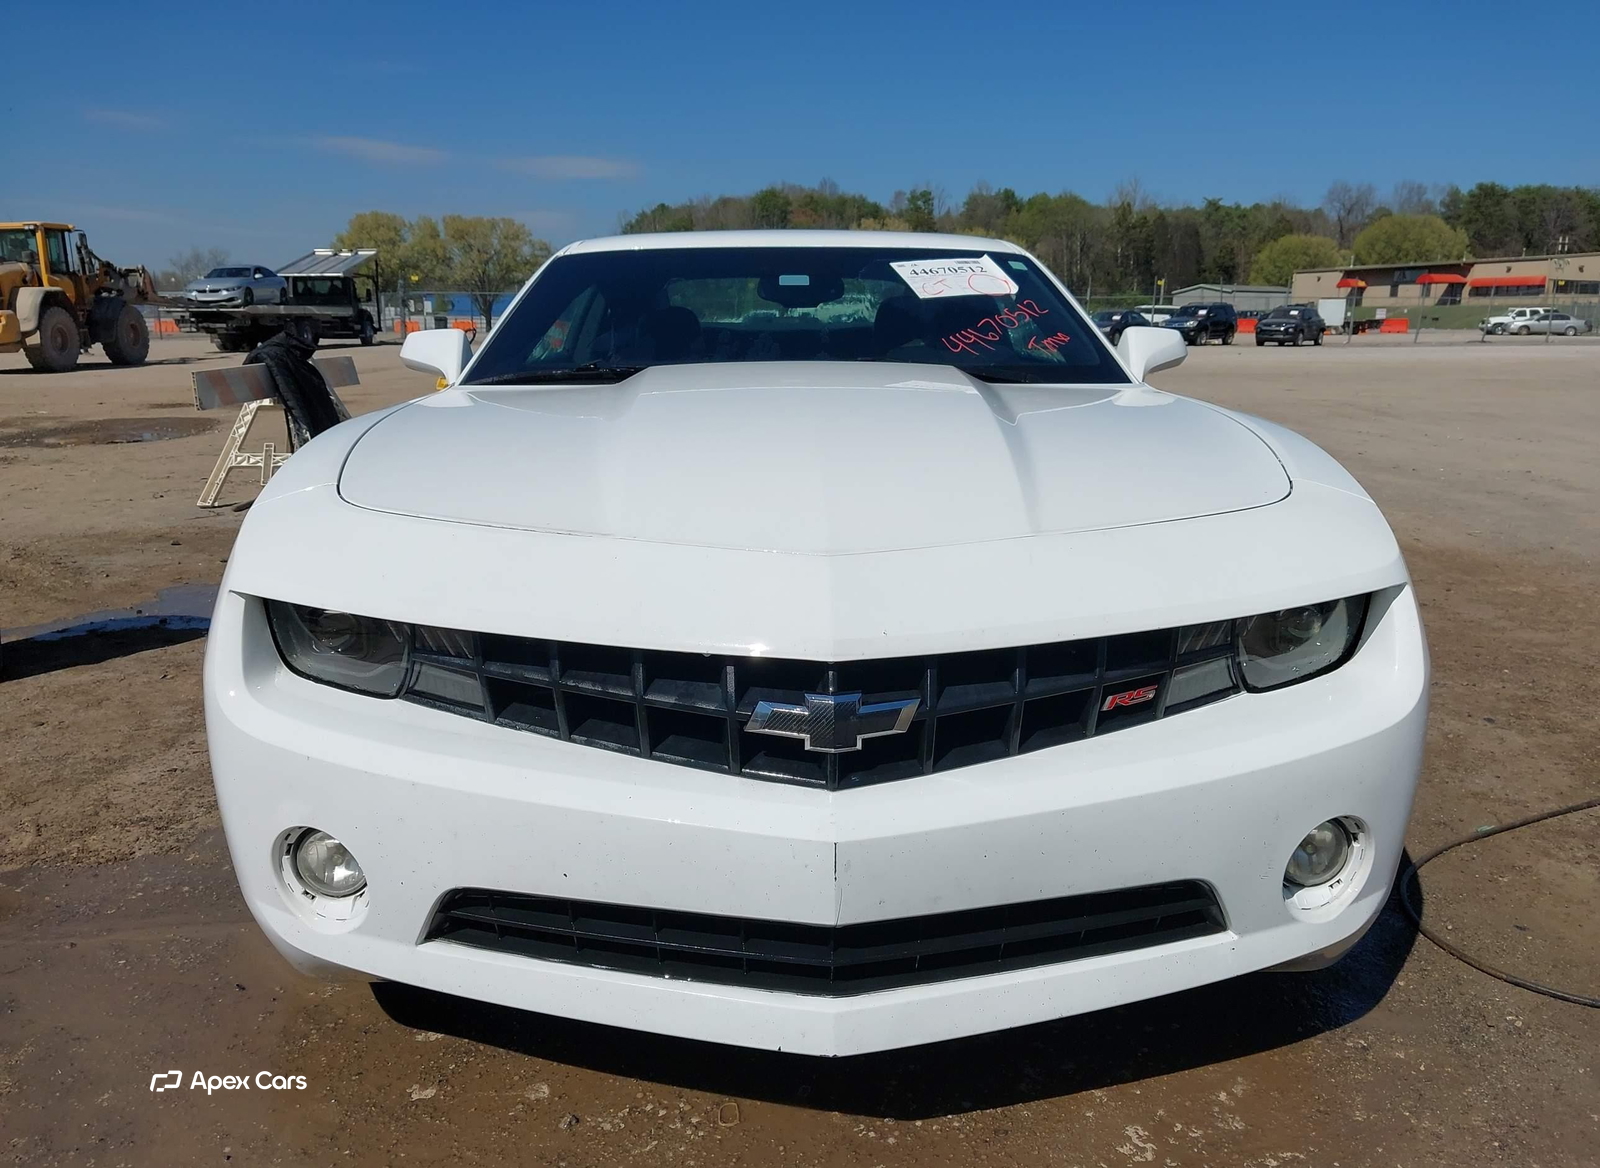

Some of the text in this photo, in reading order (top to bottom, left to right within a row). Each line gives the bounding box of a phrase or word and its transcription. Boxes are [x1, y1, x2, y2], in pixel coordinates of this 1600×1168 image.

[909, 266, 987, 276] 44670512
[941, 299, 1049, 356] 44670512
[1100, 684, 1158, 711] RS
